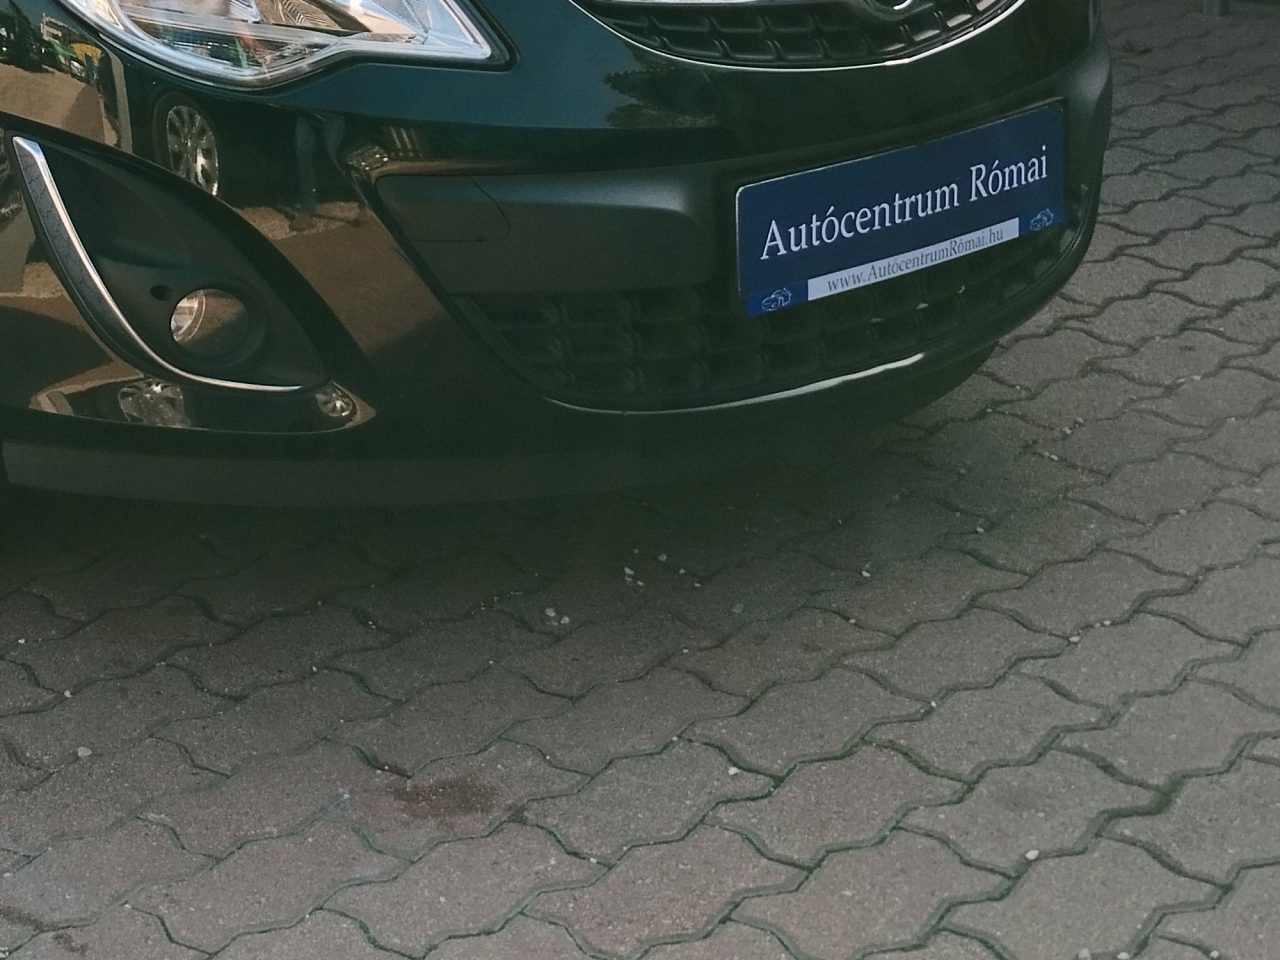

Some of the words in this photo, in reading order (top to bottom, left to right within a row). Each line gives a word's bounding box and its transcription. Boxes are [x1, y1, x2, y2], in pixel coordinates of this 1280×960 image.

[760, 183, 960, 260] Autócentrum
[969, 145, 1048, 202] Római
[827, 226, 1004, 293] www.AutócentrumRómai.hu
